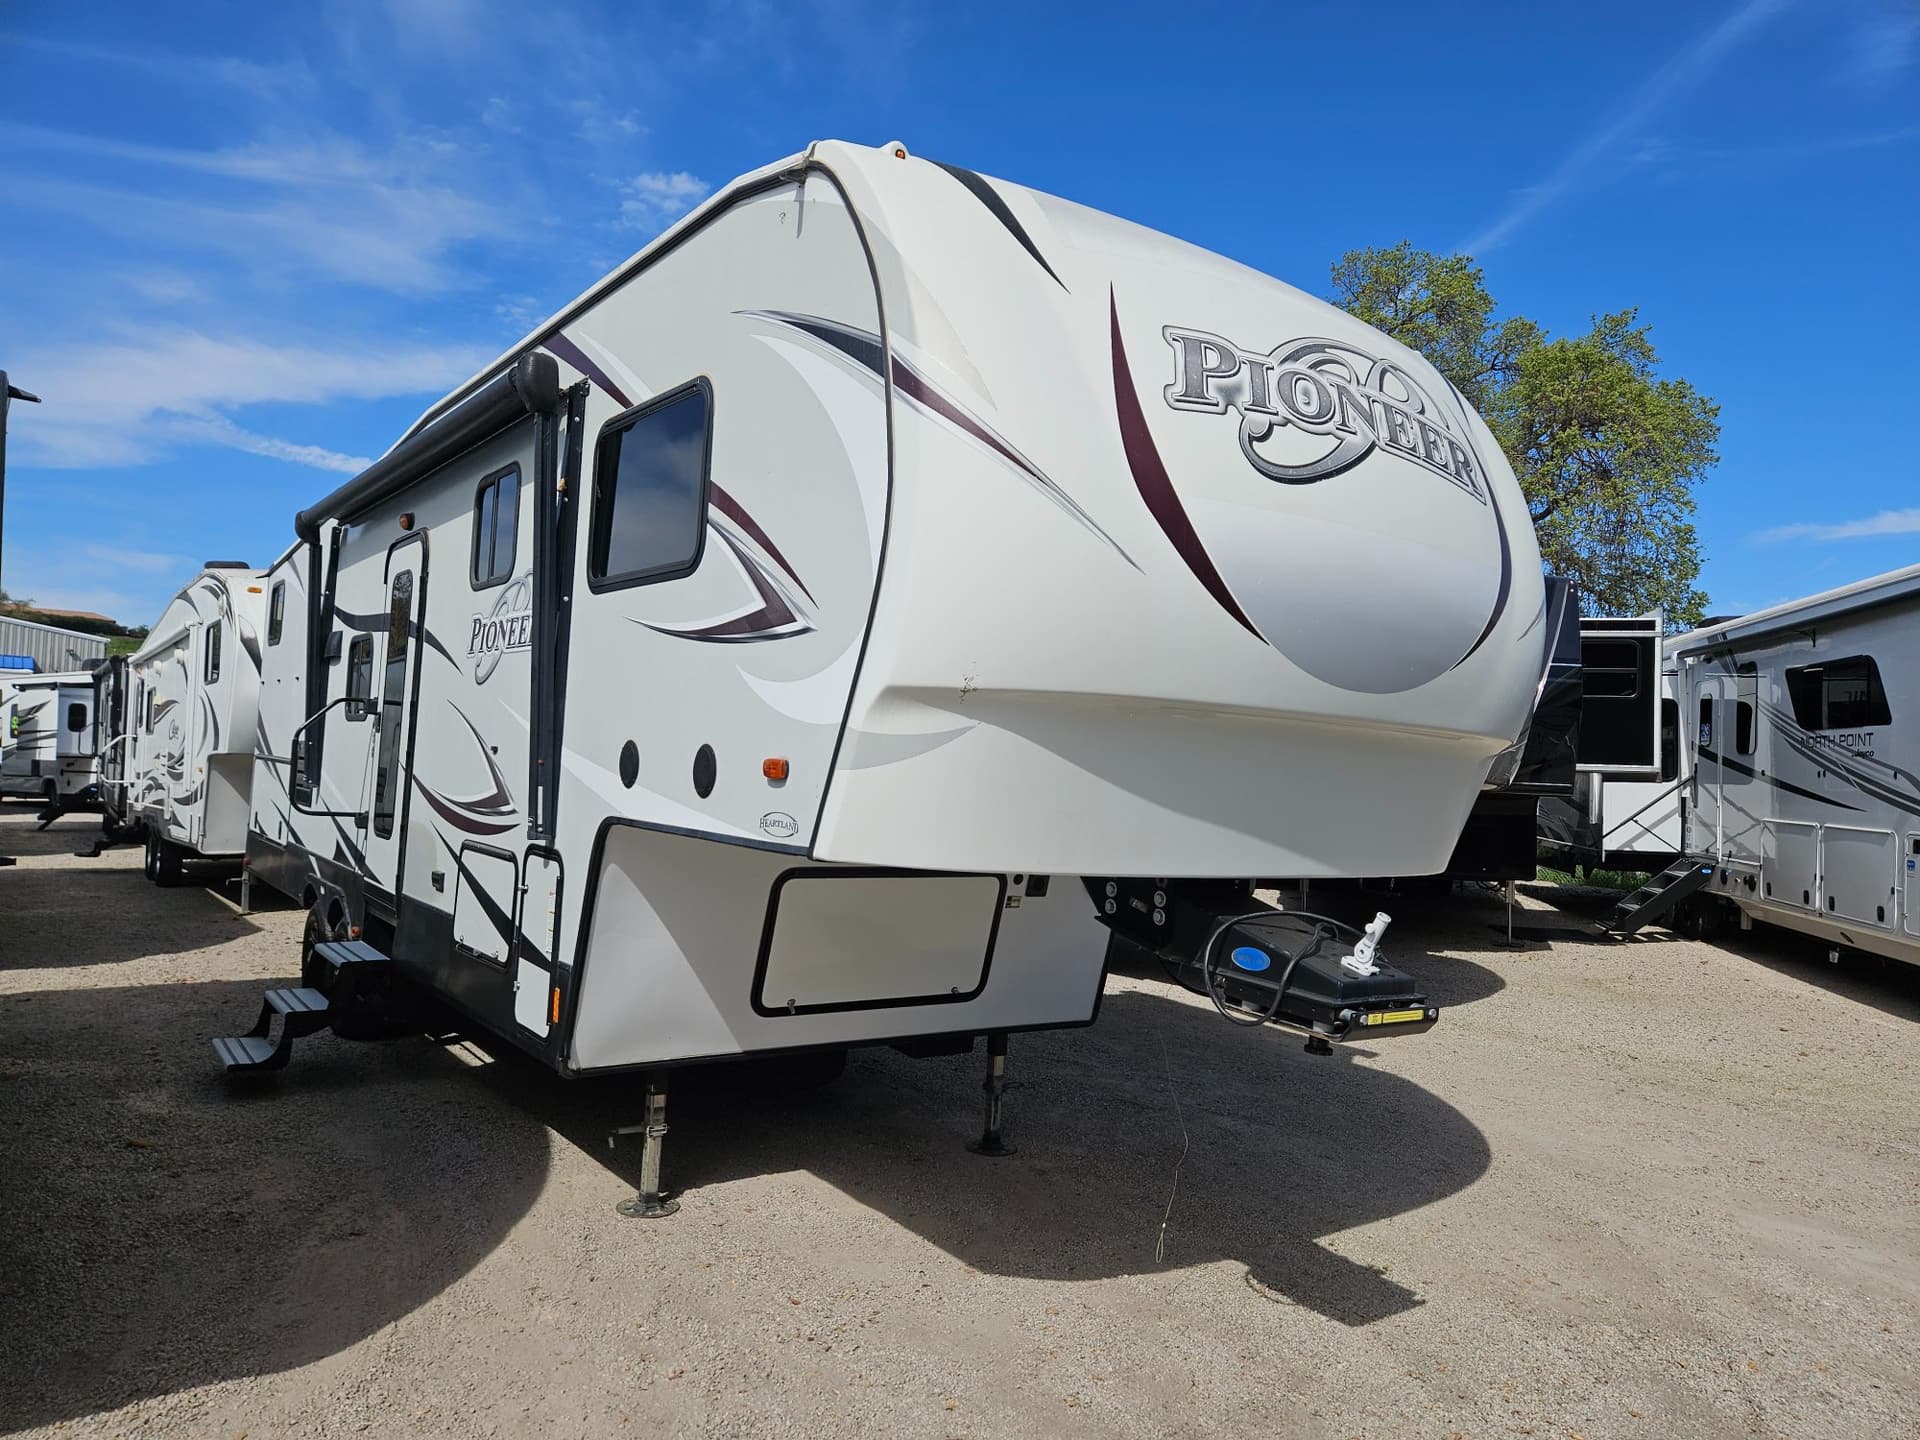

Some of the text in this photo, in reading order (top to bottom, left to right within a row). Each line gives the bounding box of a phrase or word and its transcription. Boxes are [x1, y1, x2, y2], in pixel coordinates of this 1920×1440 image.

[1167, 329, 1487, 503] PIONEER
[467, 615, 533, 655] PIONEE
[1800, 732, 1874, 749] NORTH POINT
[759, 817, 799, 835] HEARTLAND
